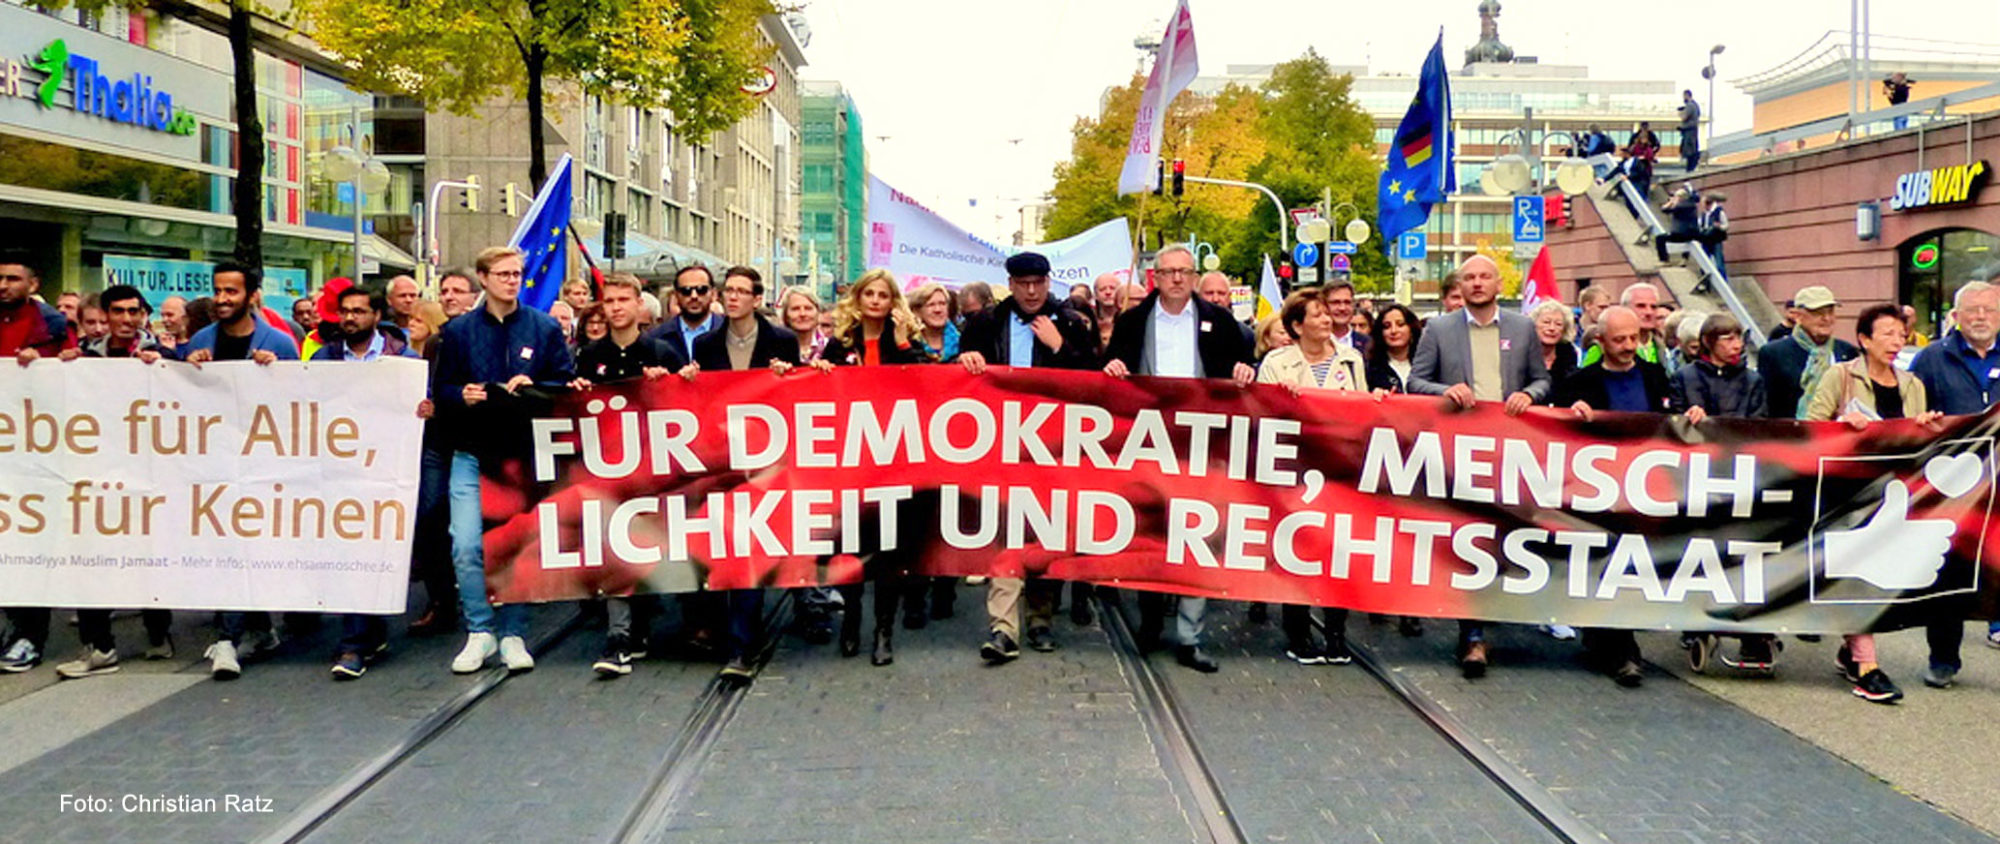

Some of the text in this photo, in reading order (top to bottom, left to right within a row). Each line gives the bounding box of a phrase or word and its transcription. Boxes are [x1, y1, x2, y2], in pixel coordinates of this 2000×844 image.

[68, 53, 197, 136] Thalia.de
[1890, 160, 1985, 210] SUBWAY
[899, 243, 918, 255] Die
[920, 246, 986, 266] Katholische
[1405, 236, 1420, 256] P
[123, 399, 222, 455] für
[241, 401, 377, 467] Alle,
[531, 394, 1795, 518] FÜR DEMOKRATIE, MENSCH-
[67, 480, 166, 535] für
[191, 483, 406, 541] Keinen
[70, 553, 118, 567] Muslim
[121, 555, 169, 570] Jamaat
[181, 556, 213, 568] Mehr
[537, 483, 1784, 605] LICHKEIT UND RECHTSSTAAT
